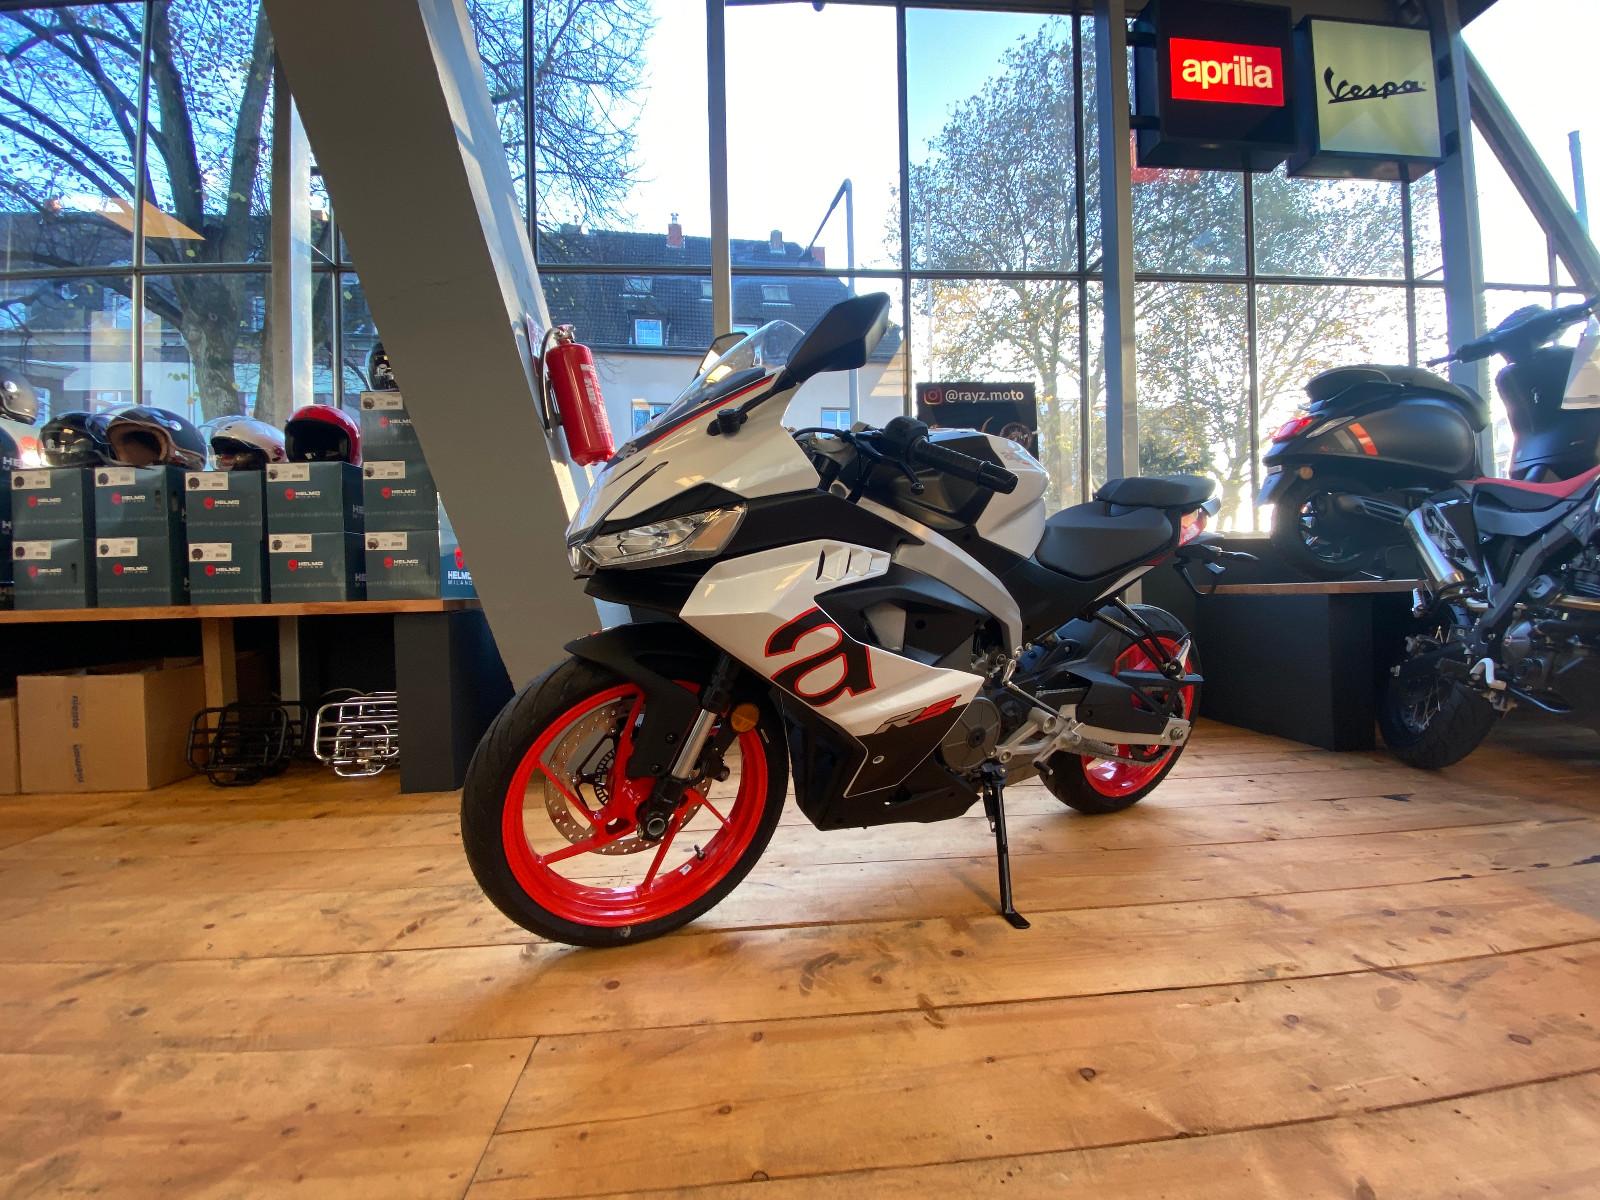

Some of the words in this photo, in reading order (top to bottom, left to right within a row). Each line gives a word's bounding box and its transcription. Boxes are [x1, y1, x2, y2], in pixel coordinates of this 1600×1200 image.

[1181, 55, 1273, 89] aprilia
[1323, 66, 1427, 104] Vespa
[945, 389, 1024, 404] @rayz.moto
